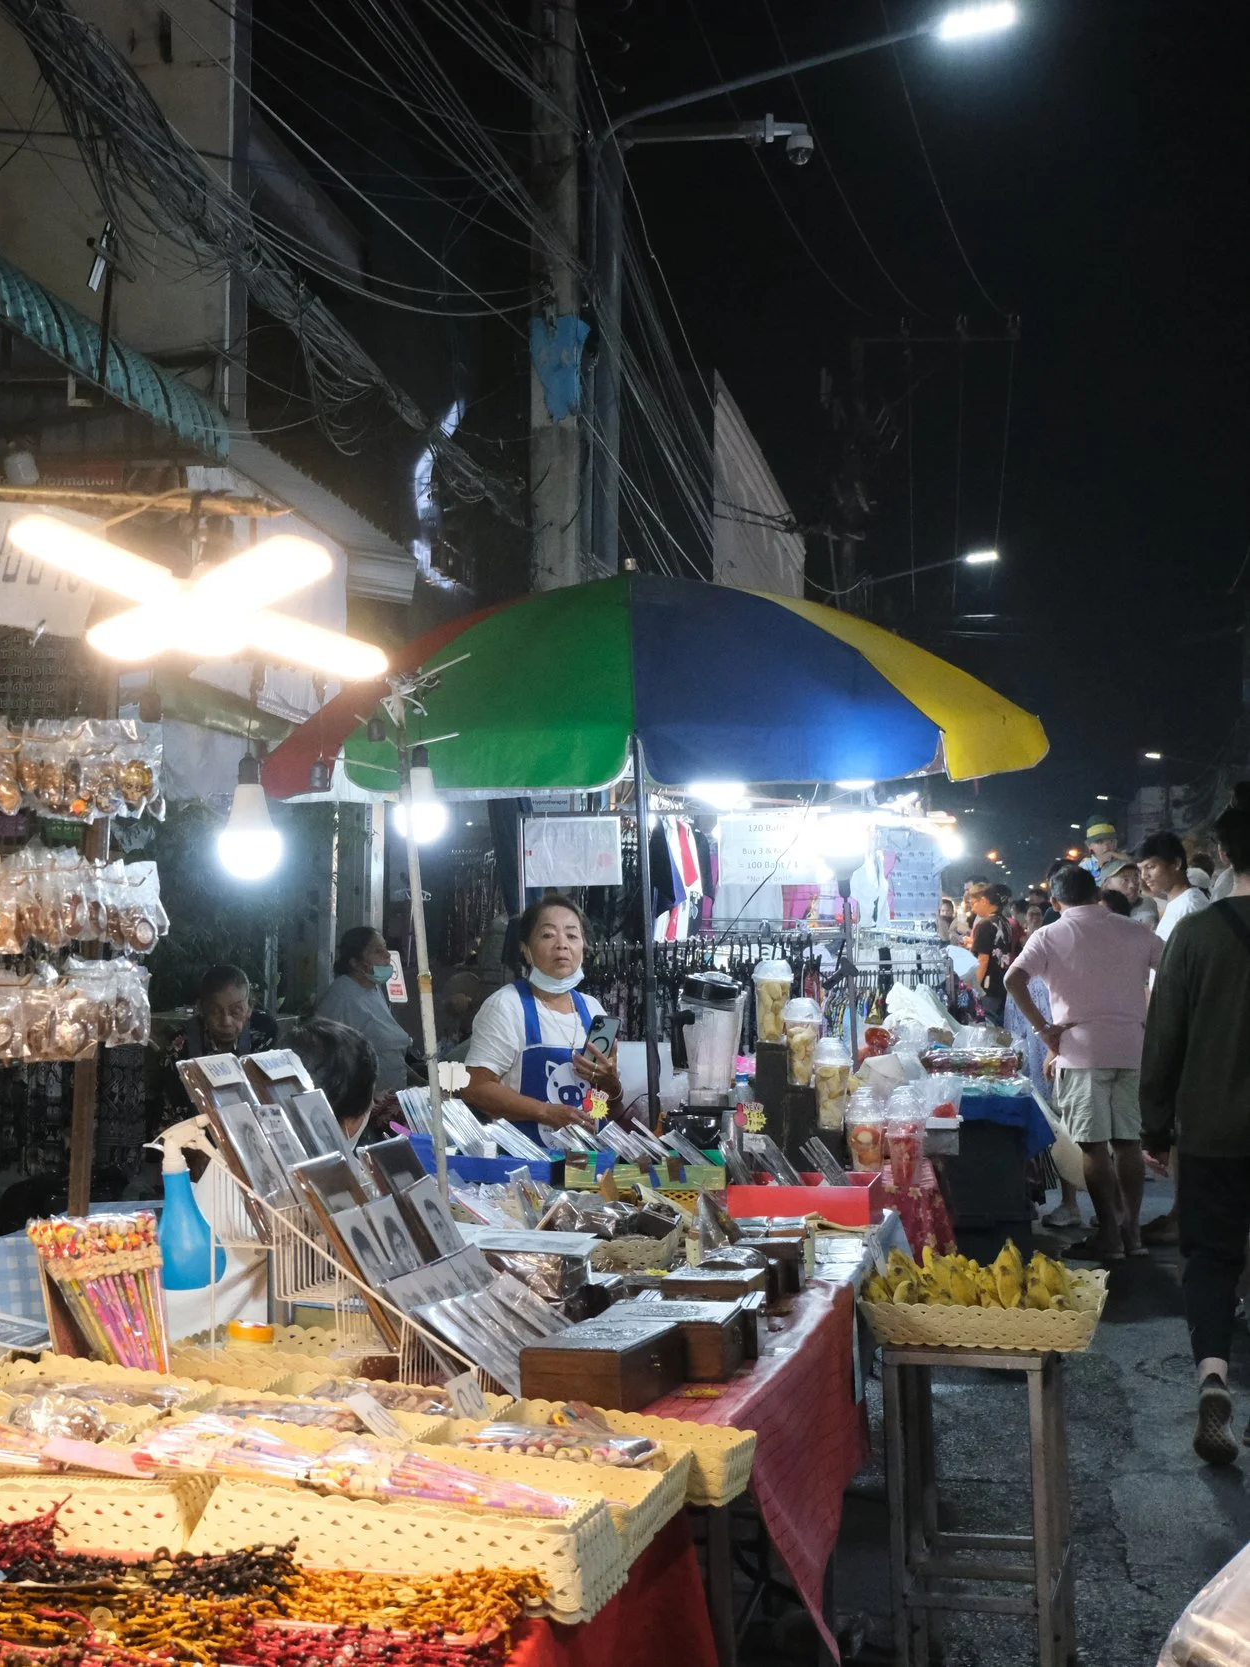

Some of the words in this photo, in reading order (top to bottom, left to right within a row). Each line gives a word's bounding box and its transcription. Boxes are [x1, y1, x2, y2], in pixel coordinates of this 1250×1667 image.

[748, 824, 763, 832] 120
[742, 847, 756, 856] Buy
[758, 847, 763, 855] 3
[747, 861, 762, 869] 100
